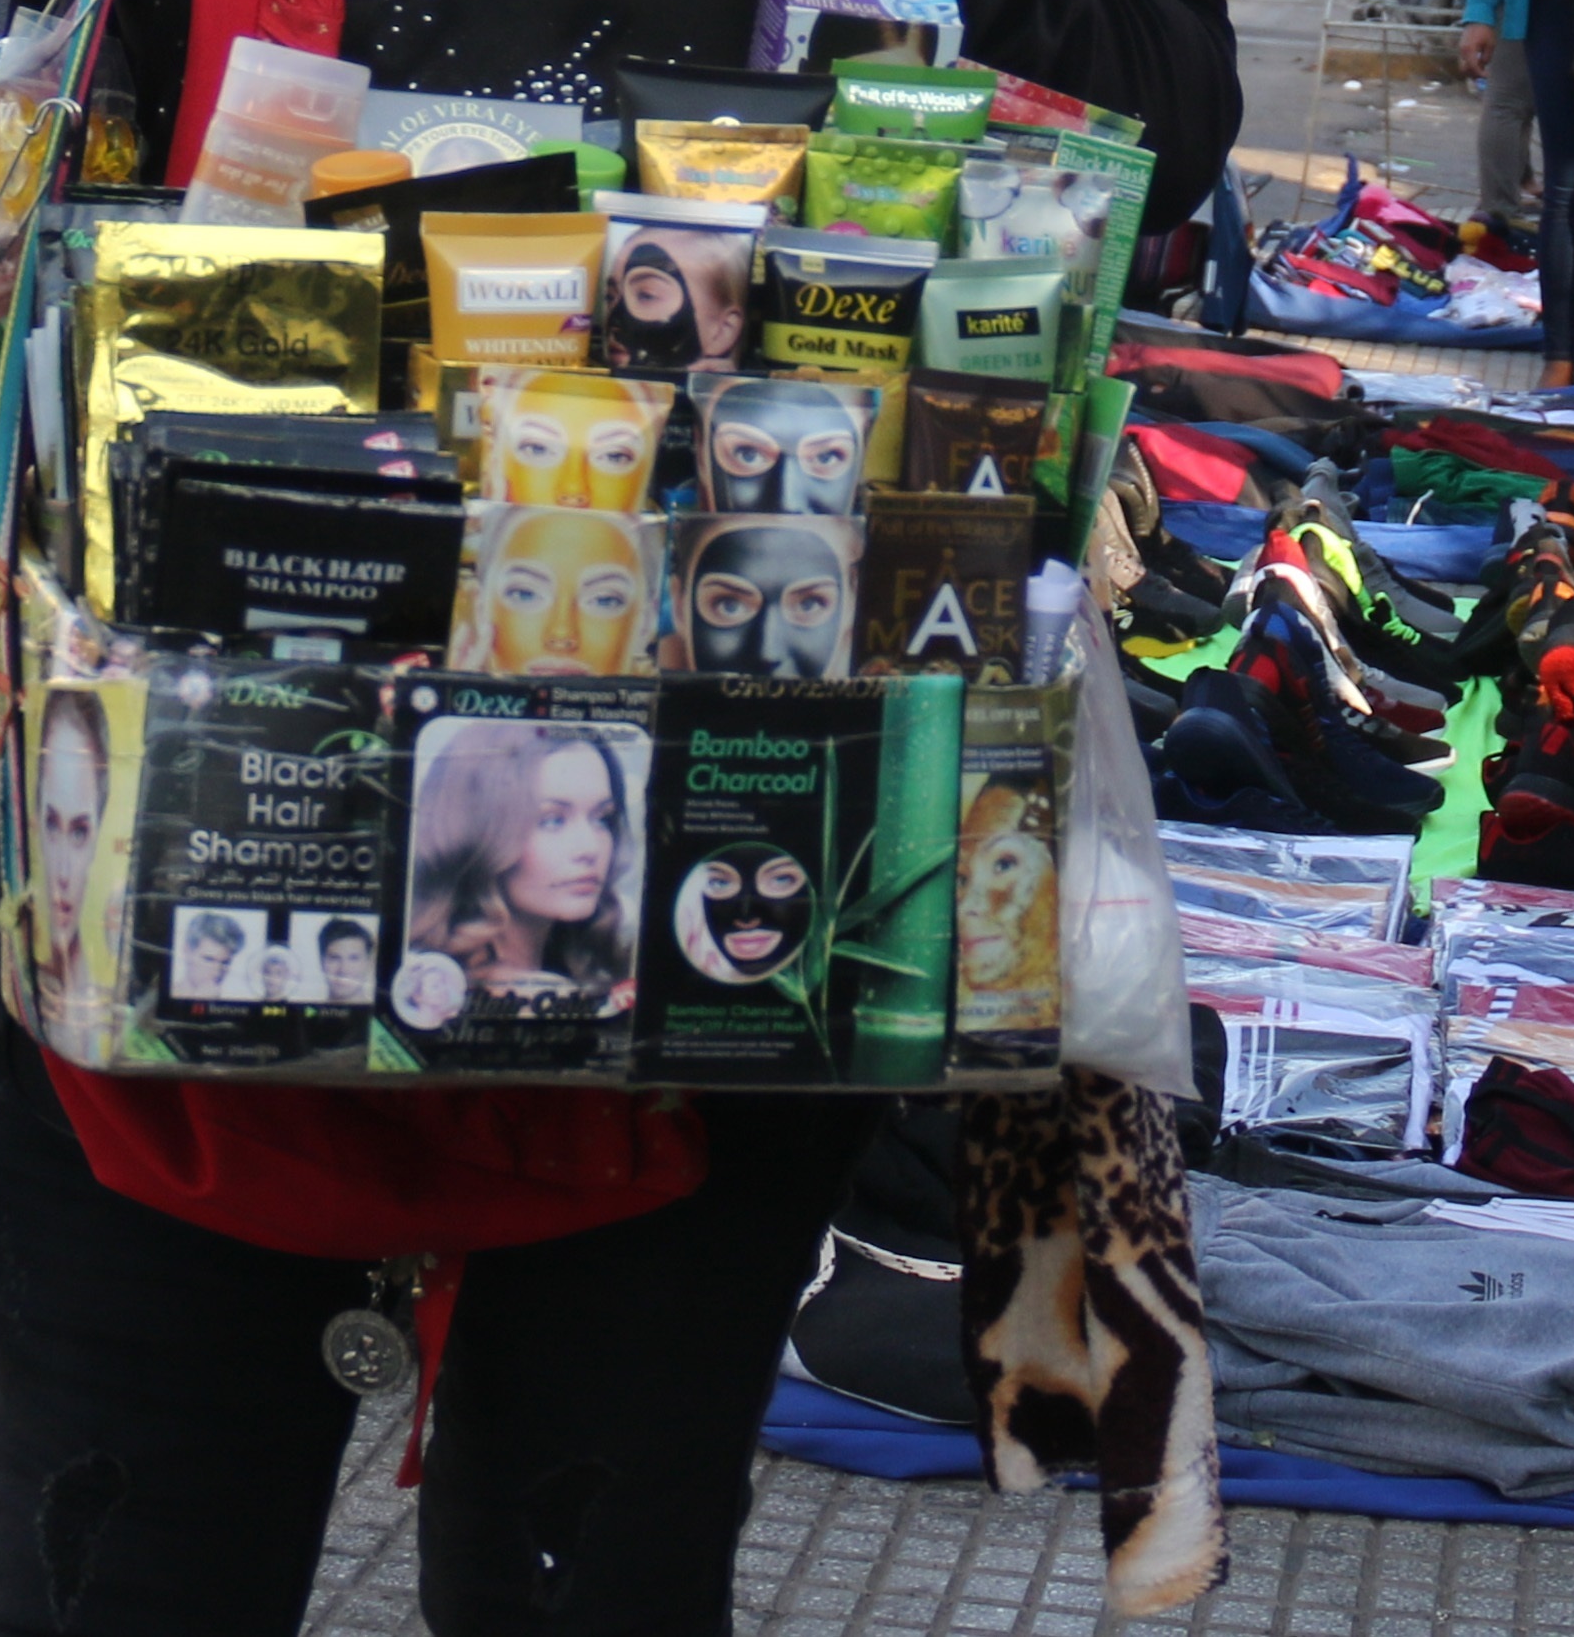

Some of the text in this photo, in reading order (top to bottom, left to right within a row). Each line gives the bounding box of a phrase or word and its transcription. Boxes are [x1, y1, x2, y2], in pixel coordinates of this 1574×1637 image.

[848, 84, 881, 102] Fruit
[880, 88, 896, 104] of
[896, 89, 919, 106] the
[379, 107, 434, 152] ALOE
[433, 101, 495, 122] VERA
[499, 112, 543, 144] EYE
[426, 124, 458, 142] YOUR
[460, 123, 485, 138] EYE
[1058, 147, 1103, 173] Black
[1106, 159, 1151, 187] Mask
[467, 279, 580, 301] WOKALI
[165, 325, 310, 360] 24K Gold
[465, 337, 579, 354] WHITENING
[787, 332, 901, 363] Gold Mask
[223, 546, 408, 584] BLACK HAIR
[245, 574, 379, 602] SHAMPOO
[689, 729, 810, 759] Bamboo
[240, 750, 346, 790] Black
[687, 763, 819, 794] Charcoal
[247, 792, 326, 828] Hair
[187, 829, 375, 874] Shampoo
[186, 886, 373, 908] Gives you black hair everyday
